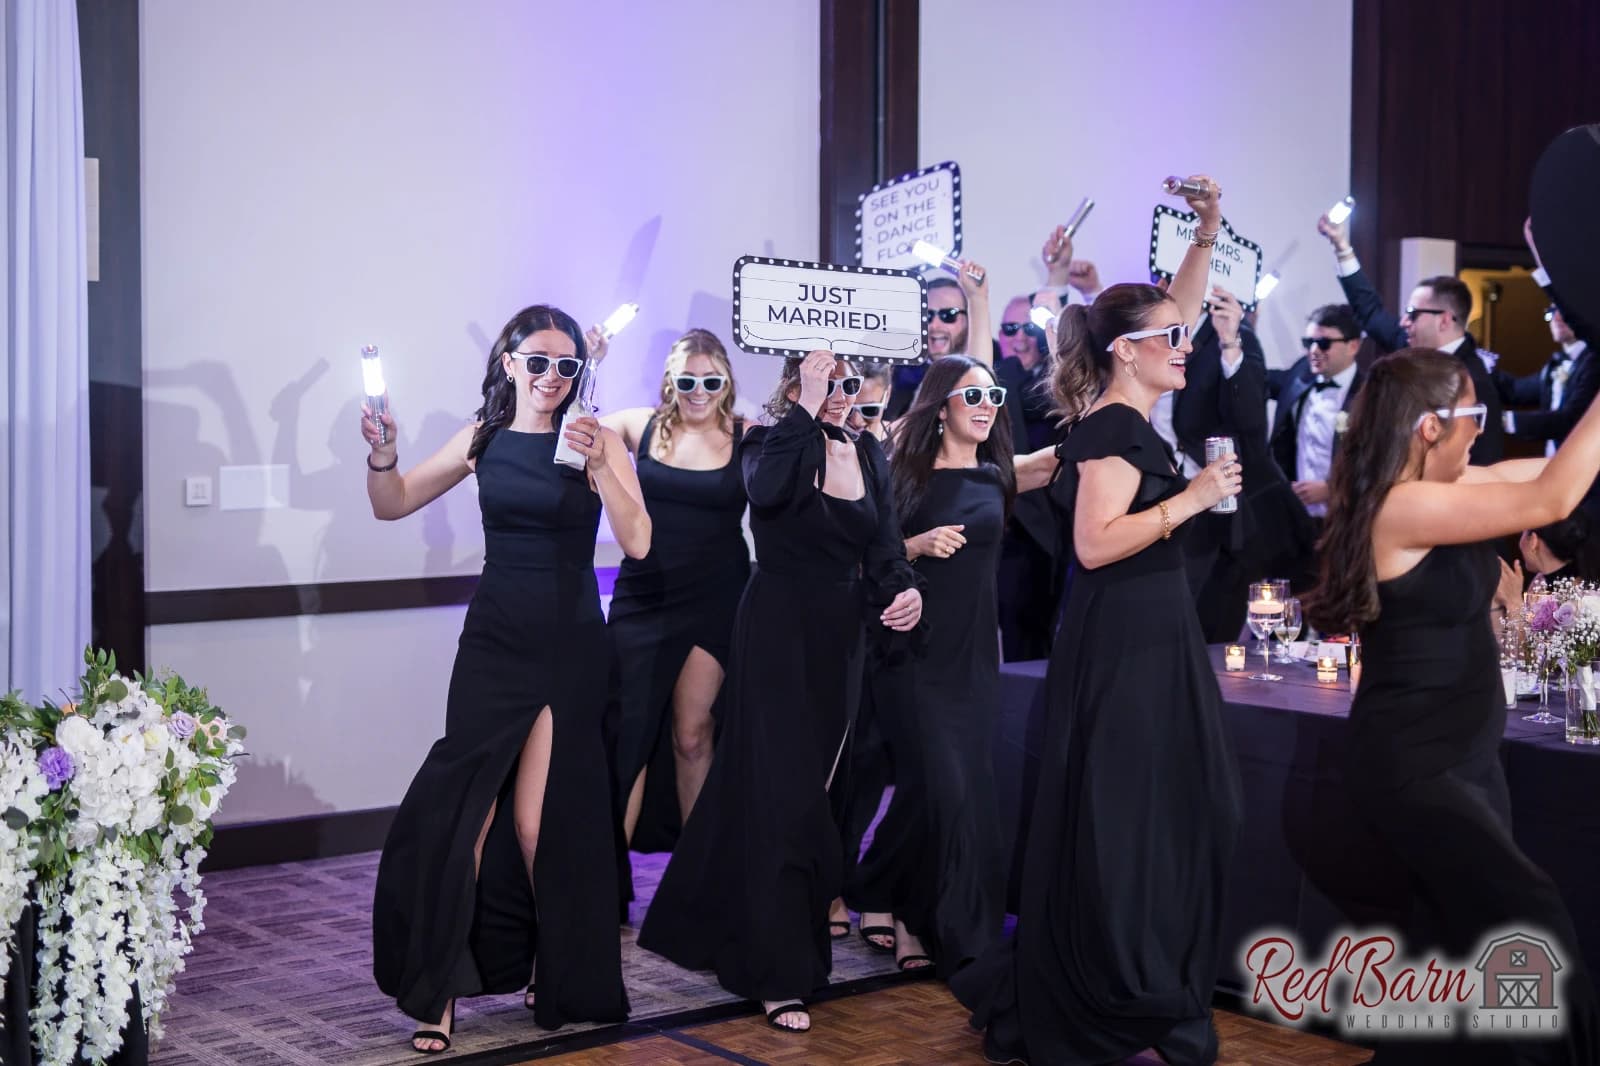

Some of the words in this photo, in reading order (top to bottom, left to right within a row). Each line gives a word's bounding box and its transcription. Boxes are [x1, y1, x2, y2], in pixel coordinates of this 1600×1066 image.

[870, 191, 899, 211] SEE
[904, 179, 939, 198] YOU
[874, 210, 898, 227] ON
[904, 197, 936, 216] THE
[878, 215, 936, 244] DANCE
[1215, 240, 1243, 263] MRS.
[798, 284, 856, 305] JUST
[768, 305, 887, 331] MARRIED!
